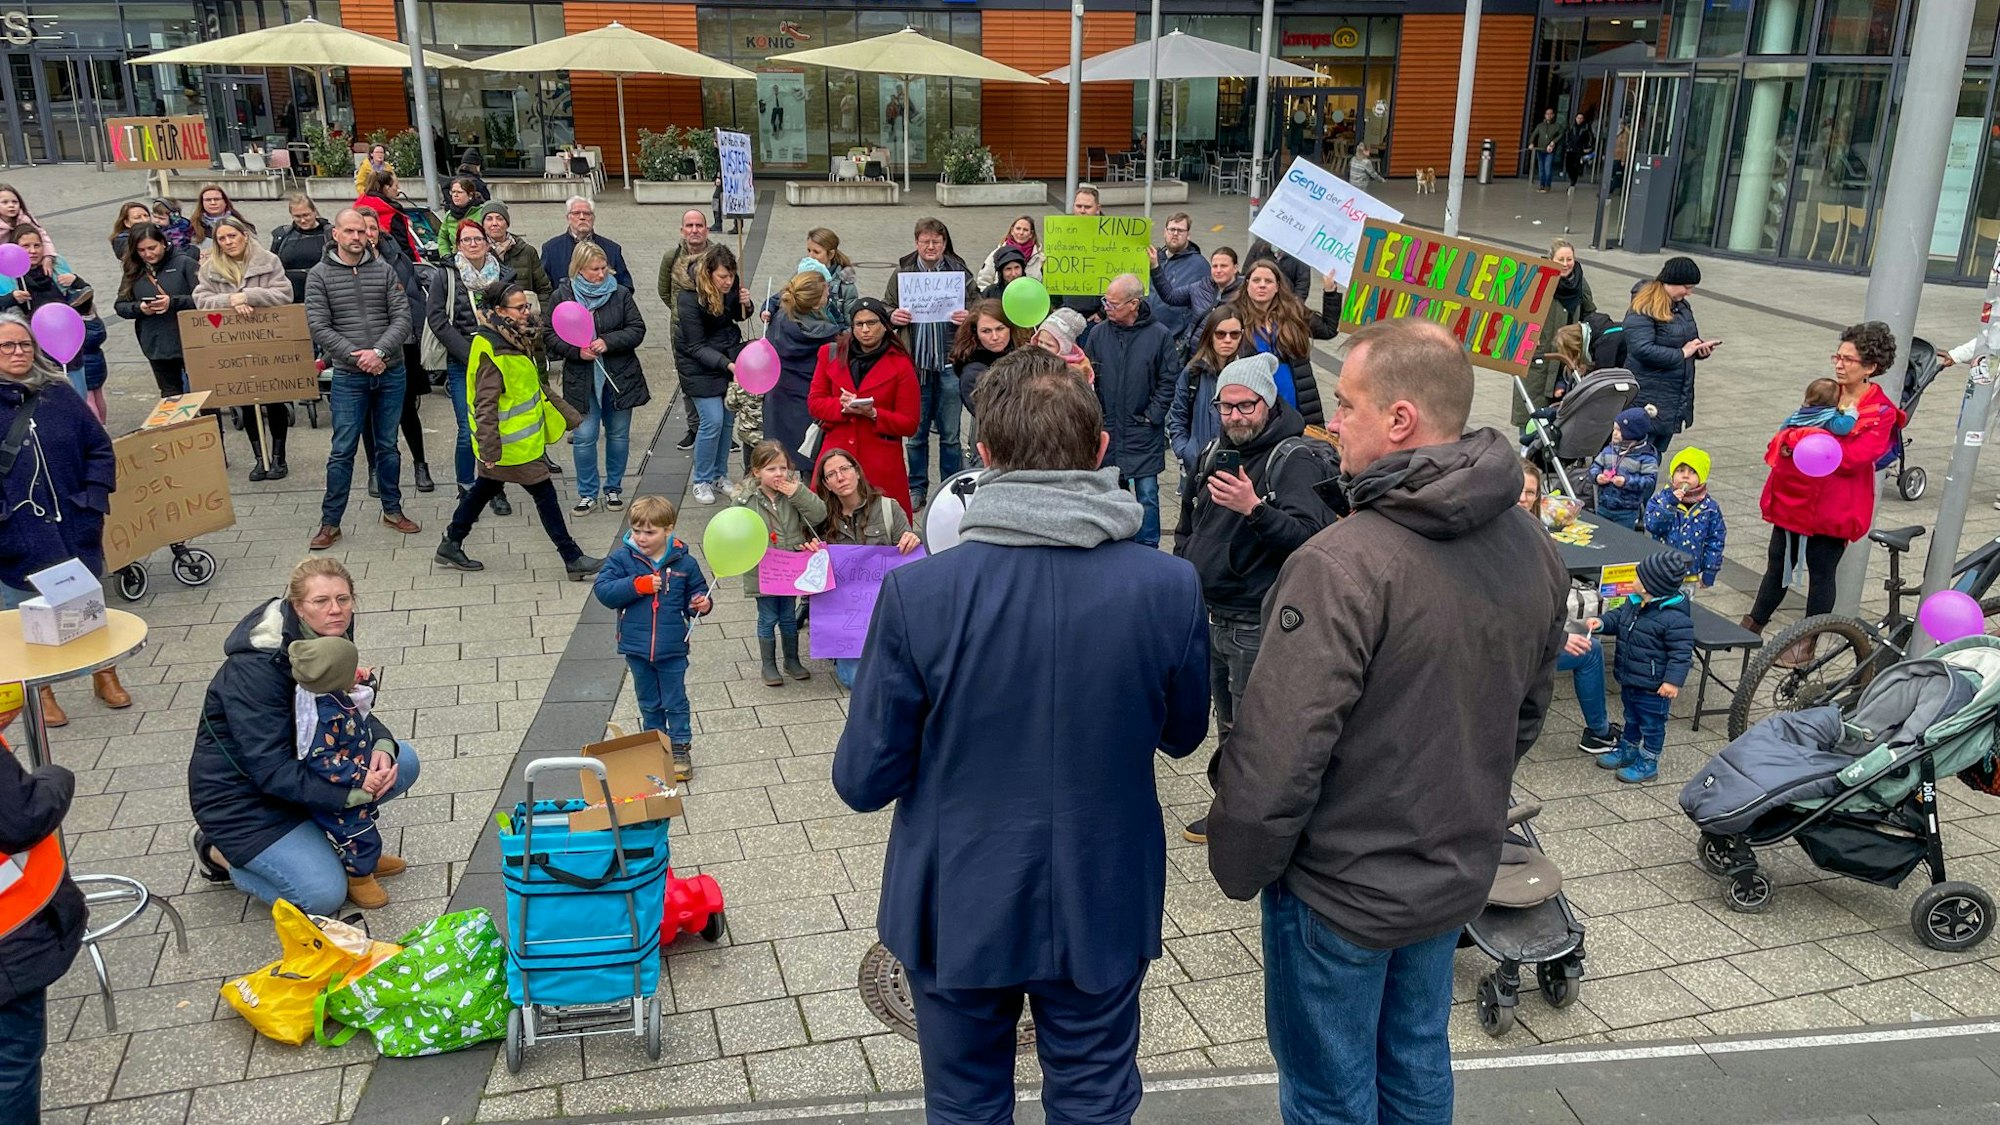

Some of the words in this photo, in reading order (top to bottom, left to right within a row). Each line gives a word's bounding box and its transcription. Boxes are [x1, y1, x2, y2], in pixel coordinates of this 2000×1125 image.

[110, 125, 159, 162] KITA
[156, 119, 182, 161] FÜR
[181, 122, 210, 161] ALLE
[1288, 169, 1327, 201] Genug
[1325, 192, 1342, 206] der
[1046, 220, 1062, 234] Um
[1067, 223, 1078, 233] ein
[1098, 216, 1147, 236] KIND
[1275, 208, 1295, 225] Zeit
[1294, 218, 1306, 232] zu
[1122, 245, 1131, 253] es
[1310, 224, 1355, 264] hande
[1046, 255, 1097, 274] DORF.
[1105, 262, 1125, 275] Doch
[1130, 262, 1144, 274] das
[1363, 226, 1459, 290] TEILEN
[1455, 250, 1561, 314] LERNT
[902, 276, 962, 295] WARUM?
[1063, 280, 1080, 292] heute
[1082, 279, 1094, 292] für
[191, 315, 210, 328] DIE
[223, 314, 241, 326] DER
[242, 312, 280, 324] KINDER
[1342, 280, 1394, 325] MAN
[1453, 306, 1541, 367] ALLEINE
[211, 329, 275, 344] GEWINNEN
[217, 356, 249, 370] SORGT
[251, 354, 270, 367] FÜR
[273, 353, 302, 365] MEHR
[153, 431, 217, 463] SIND
[134, 474, 183, 504] DER
[110, 489, 224, 551] ANFANG
[1922, 781, 1936, 803] Joie
